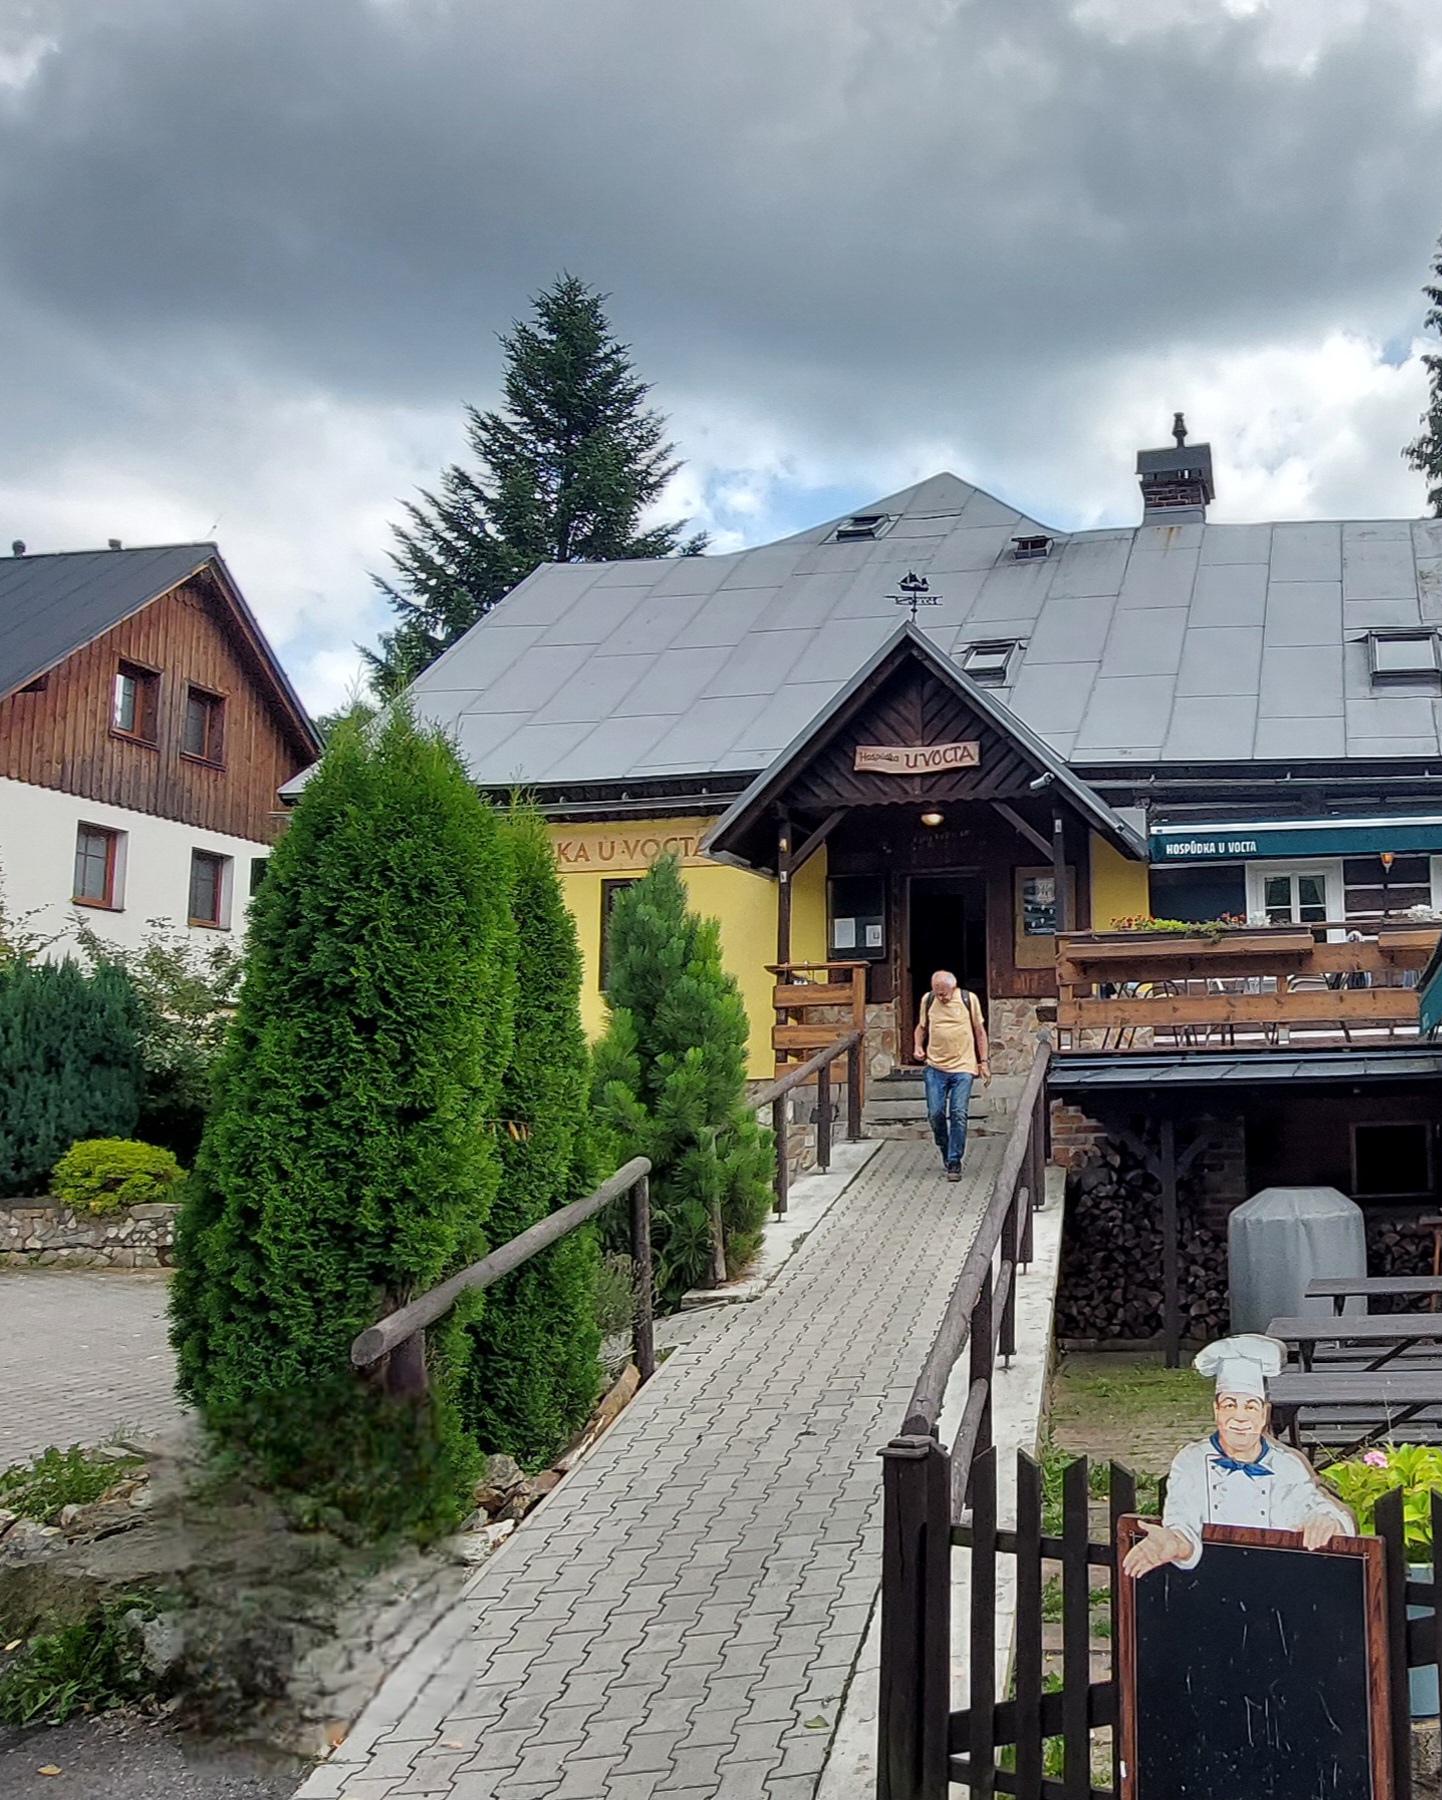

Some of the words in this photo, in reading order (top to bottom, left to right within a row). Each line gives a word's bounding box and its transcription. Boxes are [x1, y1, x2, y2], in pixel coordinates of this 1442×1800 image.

[918, 745, 976, 767] VOCTA
[557, 840, 591, 863] KA
[598, 840, 616, 861] U
[1166, 840, 1216, 855] HOSPŮDKA
[1218, 842, 1225, 853] U
[1228, 841, 1257, 853] VOCTA
